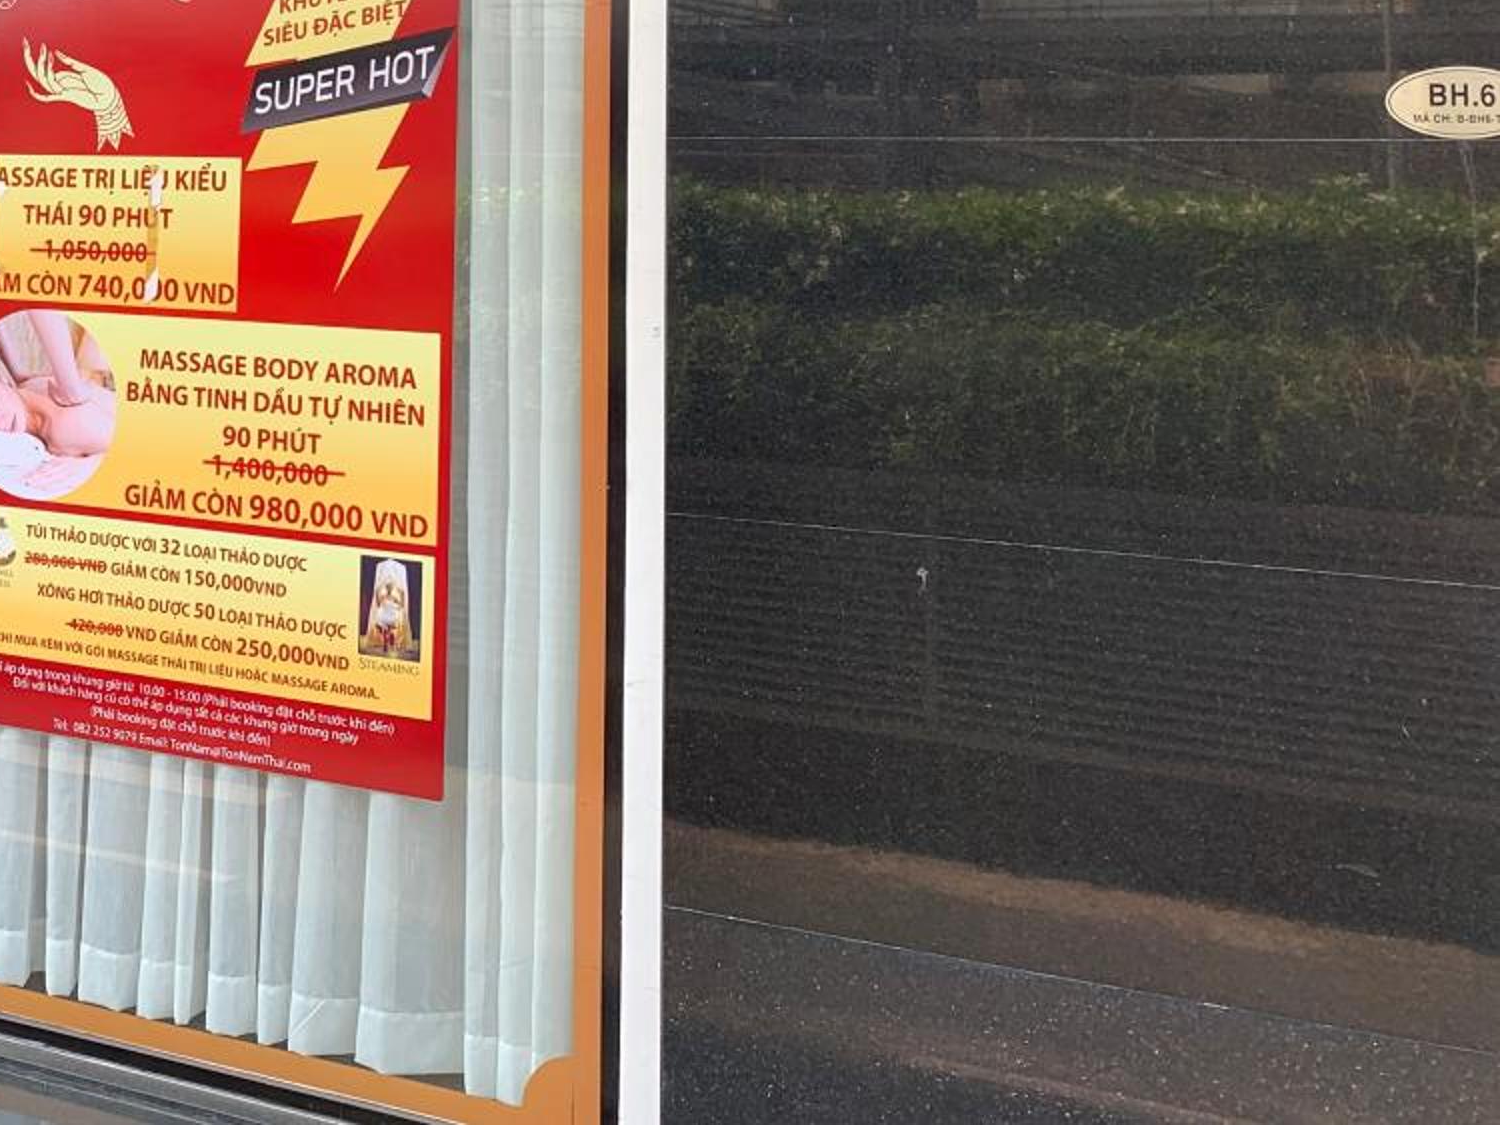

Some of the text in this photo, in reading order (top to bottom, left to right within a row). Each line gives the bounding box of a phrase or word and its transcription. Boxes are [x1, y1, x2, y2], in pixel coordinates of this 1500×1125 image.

[263, 0, 407, 46] SIÊU ĐẶC BIỆT
[255, 46, 435, 114] SUPER HOT
[1429, 83, 1495, 107] BH.6
[82, 169, 115, 195] TRỊ
[175, 163, 227, 191] KIỂU
[23, 201, 72, 225] THÁI
[79, 205, 106, 226] 90
[44, 240, 148, 263] 1,050,000
[27, 270, 72, 296] CÒN
[184, 282, 235, 304] VND
[140, 349, 417, 390] MASSAGE BODY AROMA
[126, 376, 425, 427] BẰNG TINH DẦU TỰ NHIÊN
[222, 427, 322, 455] 90 PHÚT
[212, 455, 329, 487] 1,400,000
[125, 479, 428, 538] GIẢM CÒN 980,000 VND
[50, 525, 86, 544] THẢO
[90, 531, 130, 552] DƯỢC
[160, 538, 181, 556] 32
[183, 544, 217, 564] LOẠI
[220, 547, 260, 566] THẢO
[263, 554, 308, 573] DƯỢC
[111, 560, 147, 579] GIẢM
[151, 564, 180, 583] CÒN
[185, 568, 287, 598] 150,000VND
[37, 582, 76, 601] XÔNG
[107, 591, 145, 611] THẢO
[148, 597, 190, 619] DƯỢC
[194, 603, 215, 620] 50
[219, 608, 252, 629] LOẠI
[255, 612, 297, 632] THẢO
[301, 620, 347, 642] DƯỢC
[126, 624, 156, 642] VND
[159, 628, 197, 649] GIẢM
[201, 632, 233, 654] CÒN
[236, 638, 349, 671] 250,000VND
[108, 648, 158, 666] MASSAGE
[272, 673, 328, 691] MASSAGE
